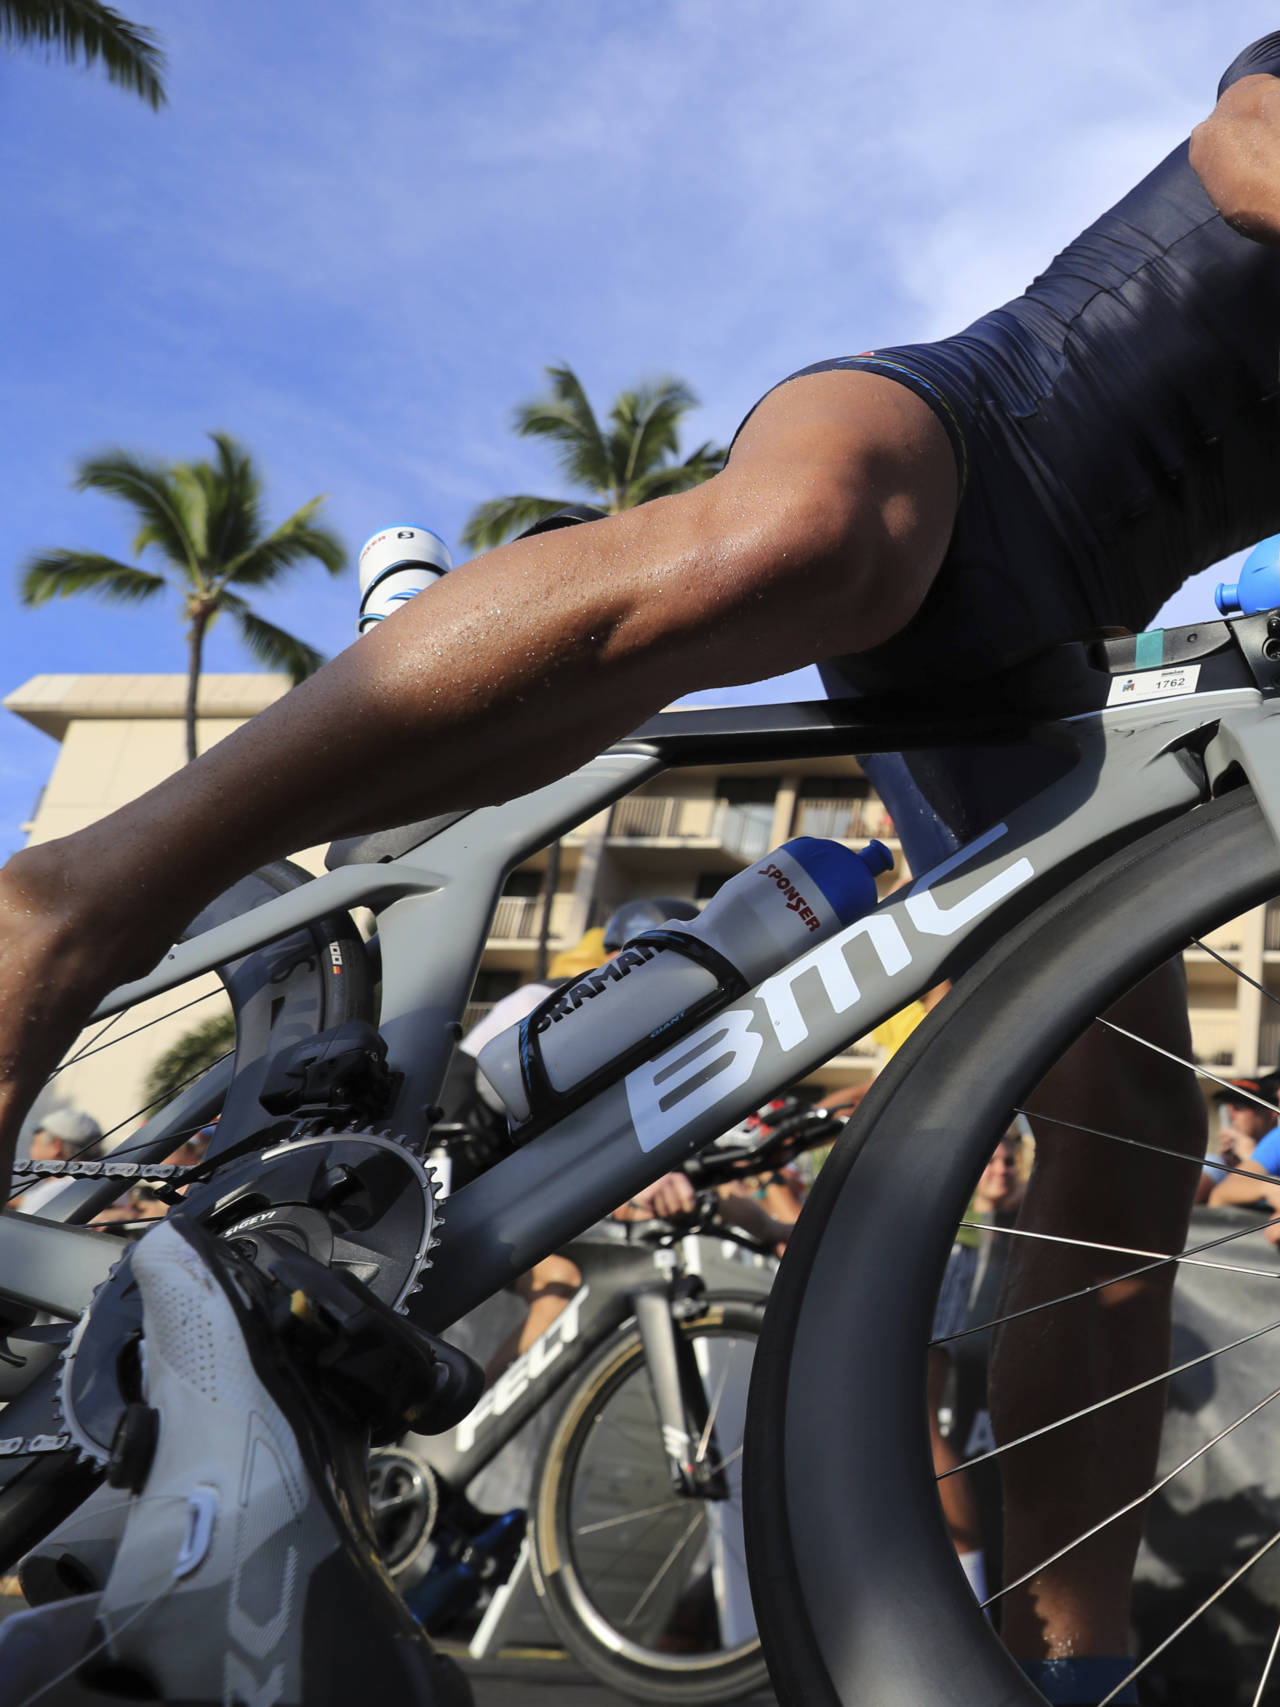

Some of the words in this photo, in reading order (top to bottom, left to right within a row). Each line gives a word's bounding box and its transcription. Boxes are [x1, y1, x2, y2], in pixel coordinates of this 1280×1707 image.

[1156, 678, 1185, 689] 1762
[758, 864, 820, 932] SPONSER
[224, 1211, 276, 1238] SIGEYI
[455, 1284, 590, 1452] FELT
